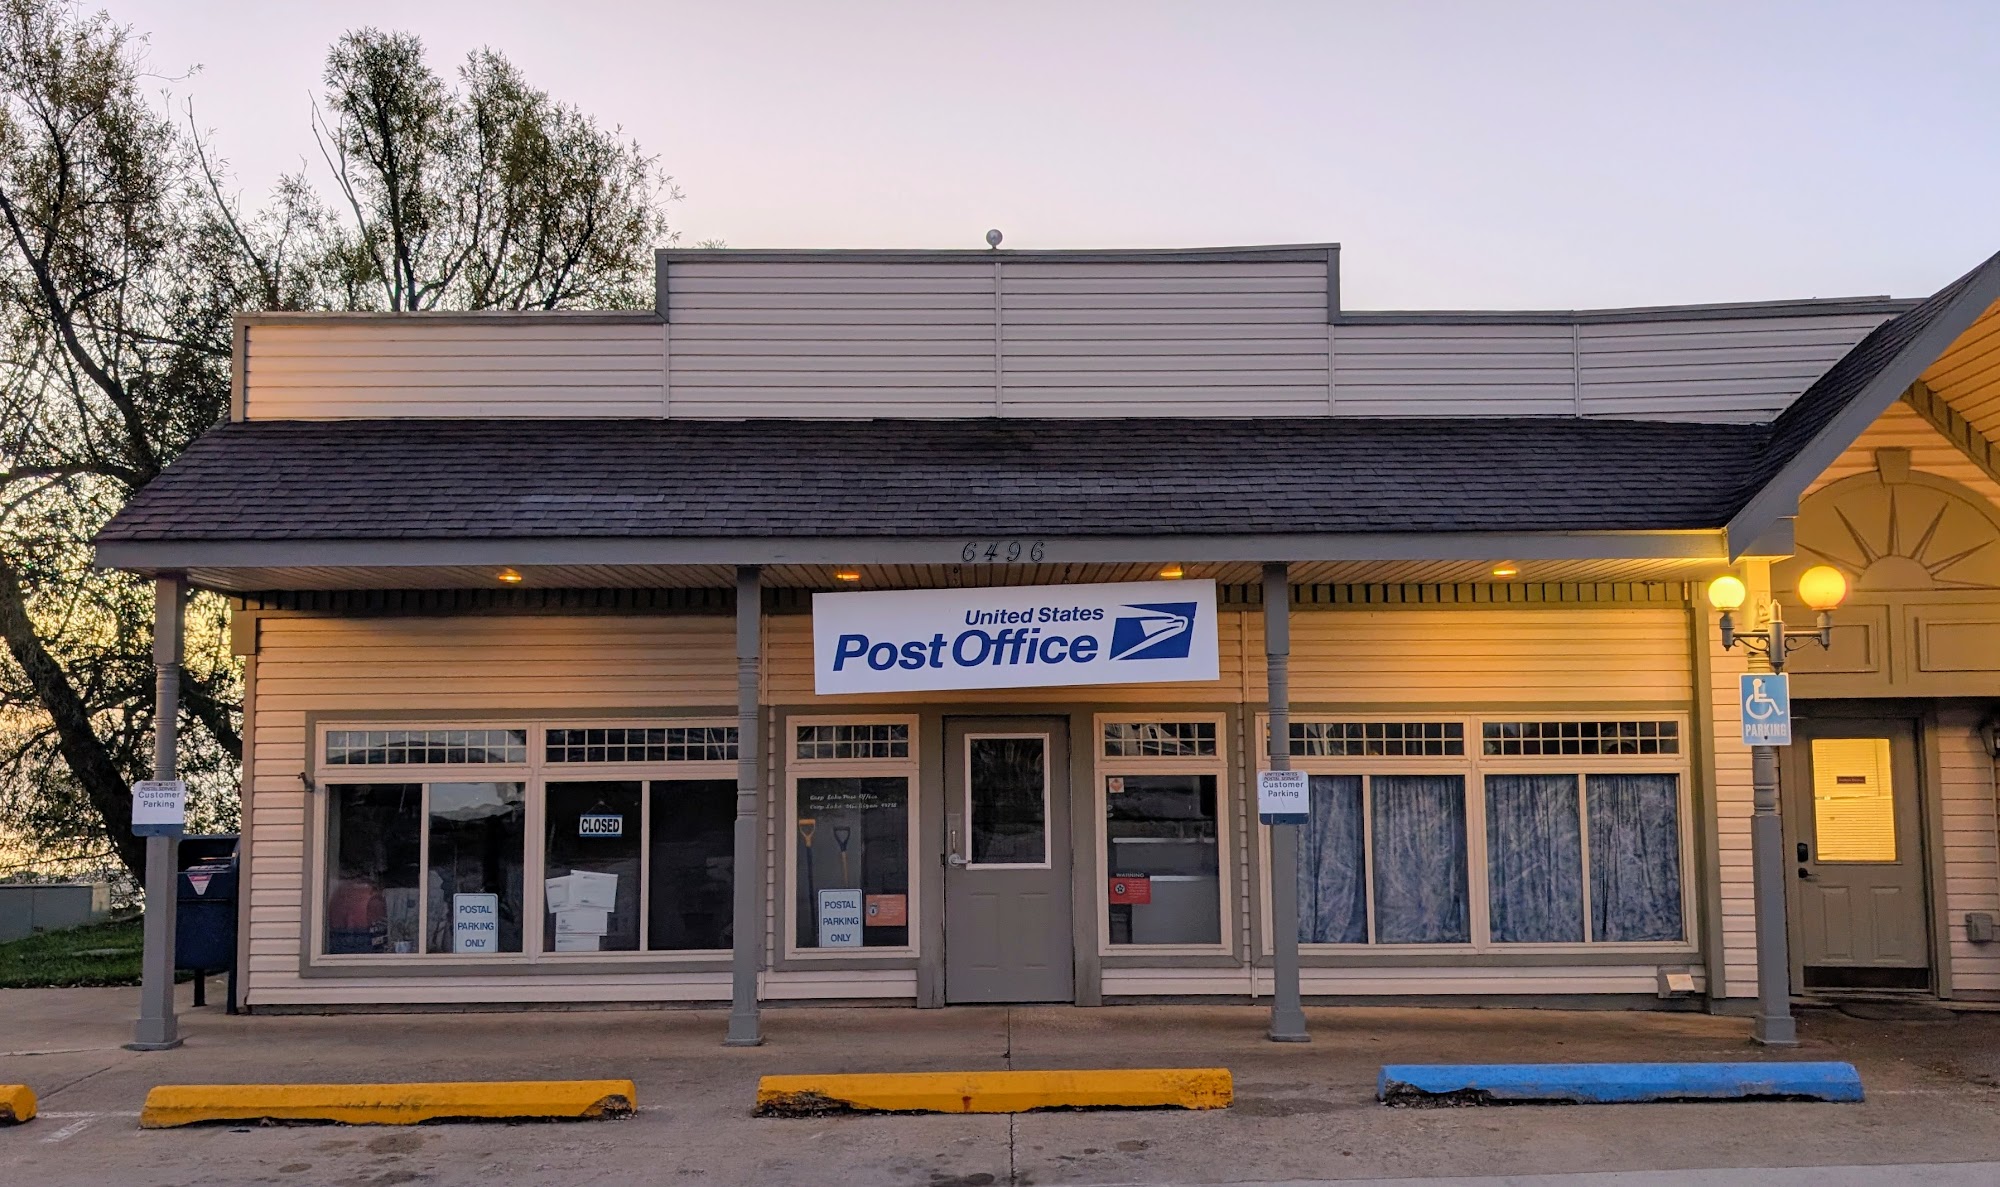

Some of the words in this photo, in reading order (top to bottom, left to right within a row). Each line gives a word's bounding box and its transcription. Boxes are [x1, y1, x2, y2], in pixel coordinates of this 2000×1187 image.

[962, 541, 1044, 562] 6496
[965, 607, 1033, 626] United
[1037, 605, 1104, 624] States
[832, 632, 947, 672] Post
[952, 627, 1099, 668] Office
[1745, 723, 1786, 737] PARKING
[138, 791, 181, 799] Customer
[1268, 790, 1299, 799] Parking
[143, 801, 175, 809] Parking
[581, 818, 620, 833] CLOSED
[459, 905, 493, 914] POSTAL
[824, 901, 856, 909] POSTAL
[822, 917, 859, 926] PARKING
[457, 922, 495, 931] PARKING
[830, 934, 852, 942] ONLY
[465, 939, 486, 948] ONLY
